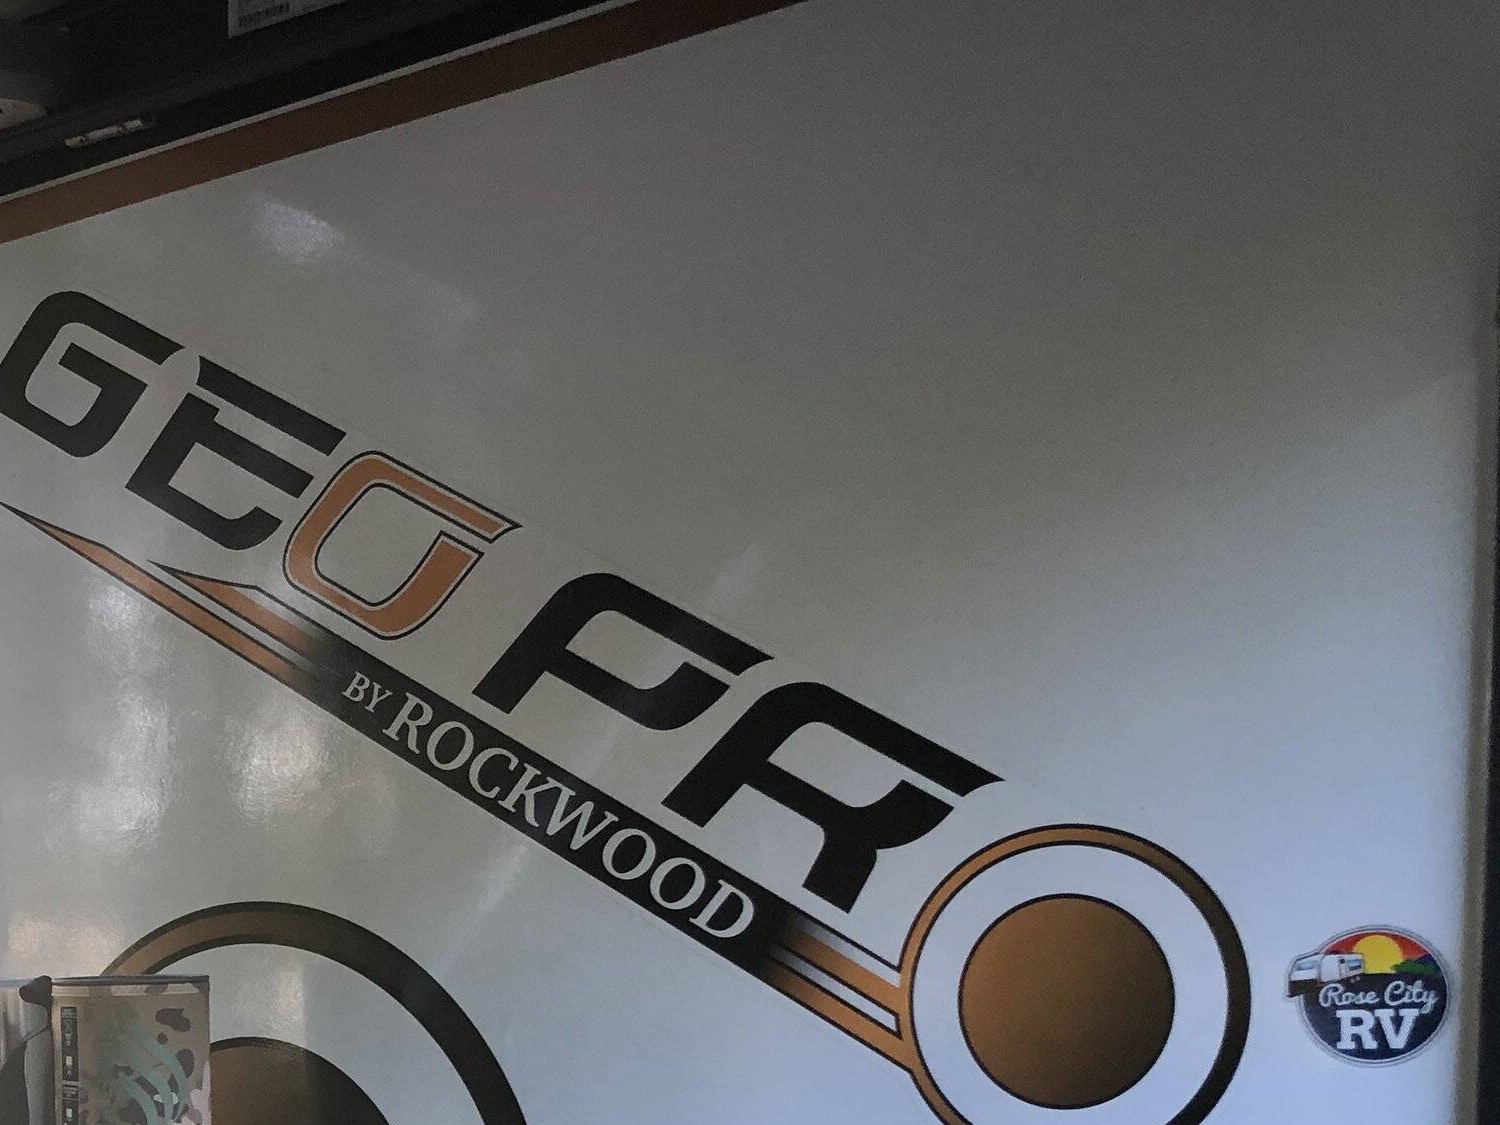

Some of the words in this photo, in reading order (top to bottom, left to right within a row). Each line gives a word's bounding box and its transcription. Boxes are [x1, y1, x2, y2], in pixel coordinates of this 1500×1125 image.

[342, 671, 393, 714] BY
[387, 692, 755, 939] ROCKWOOD
[1318, 983, 1380, 1007] Rose
[1384, 980, 1438, 1014] City
[1335, 1008, 1419, 1050] RV
